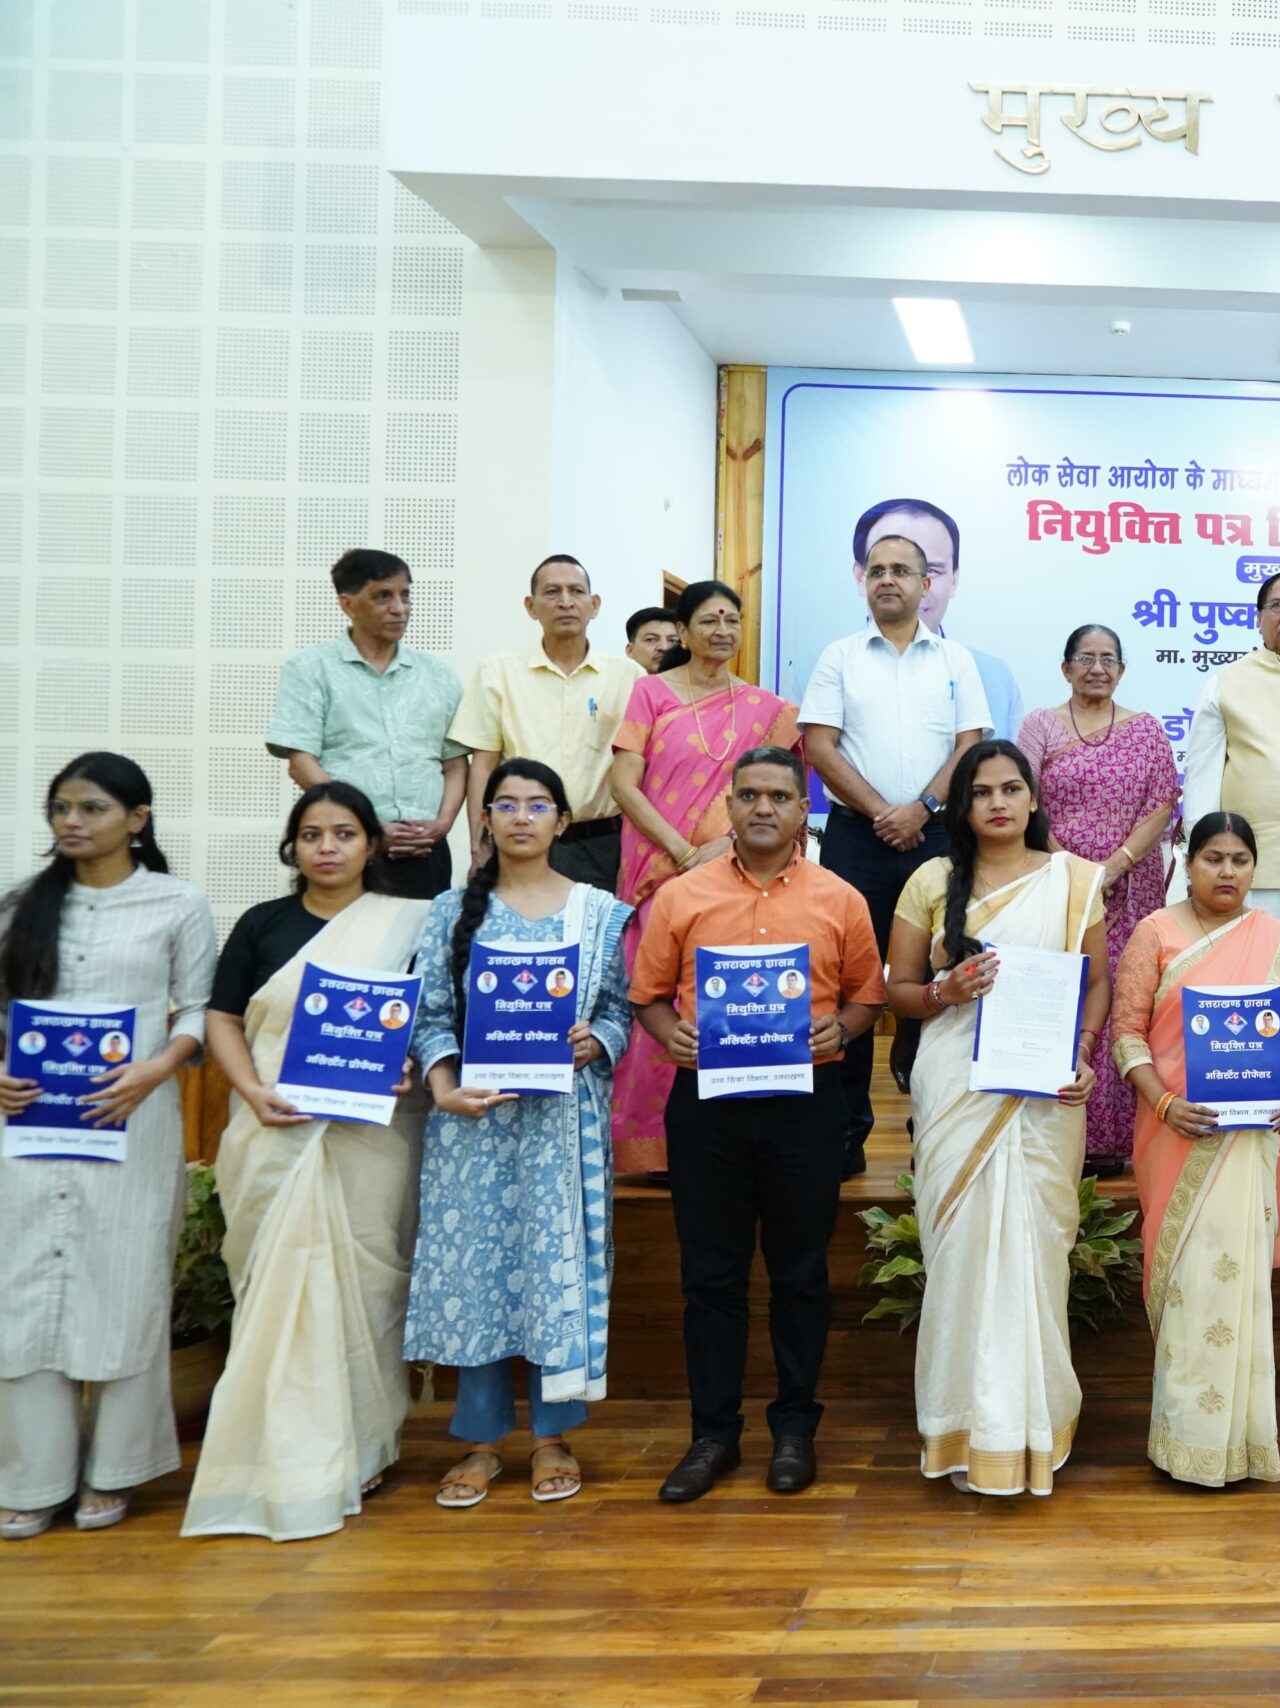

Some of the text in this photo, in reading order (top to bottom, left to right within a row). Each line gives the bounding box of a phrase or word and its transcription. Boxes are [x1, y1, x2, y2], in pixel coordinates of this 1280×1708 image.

[967, 81, 1214, 175] मुख्य
[1006, 456, 1049, 488] लोक
[1057, 456, 1097, 488] सेवा
[1107, 459, 1178, 491] आयोग
[1186, 460, 1203, 491] के
[1212, 466, 1279, 493] माध्यम
[1026, 499, 1181, 555] नियुक्ति
[1194, 512, 1254, 546] पत्र
[1131, 587, 1181, 629] श्री
[1155, 649, 1186, 664] मा.
[487, 956, 566, 966] उत्तराखण्ड शासन
[714, 958, 796, 970] उत्तराखण्ड शासन
[319, 978, 405, 997] उत्तराखण्ड शासन
[495, 999, 553, 1012] नियुक्ति पत्र
[726, 1003, 786, 1016] नियुक्ति पत्र
[1198, 999, 1271, 1008] उत्तराखण्ड शासन
[719, 1032, 794, 1046] असिस्टेंट प्रोफेसर
[1211, 1041, 1263, 1052] नियुक्ति पत्र
[1205, 1069, 1272, 1080] असिस्टेंट प्रोफेसर
